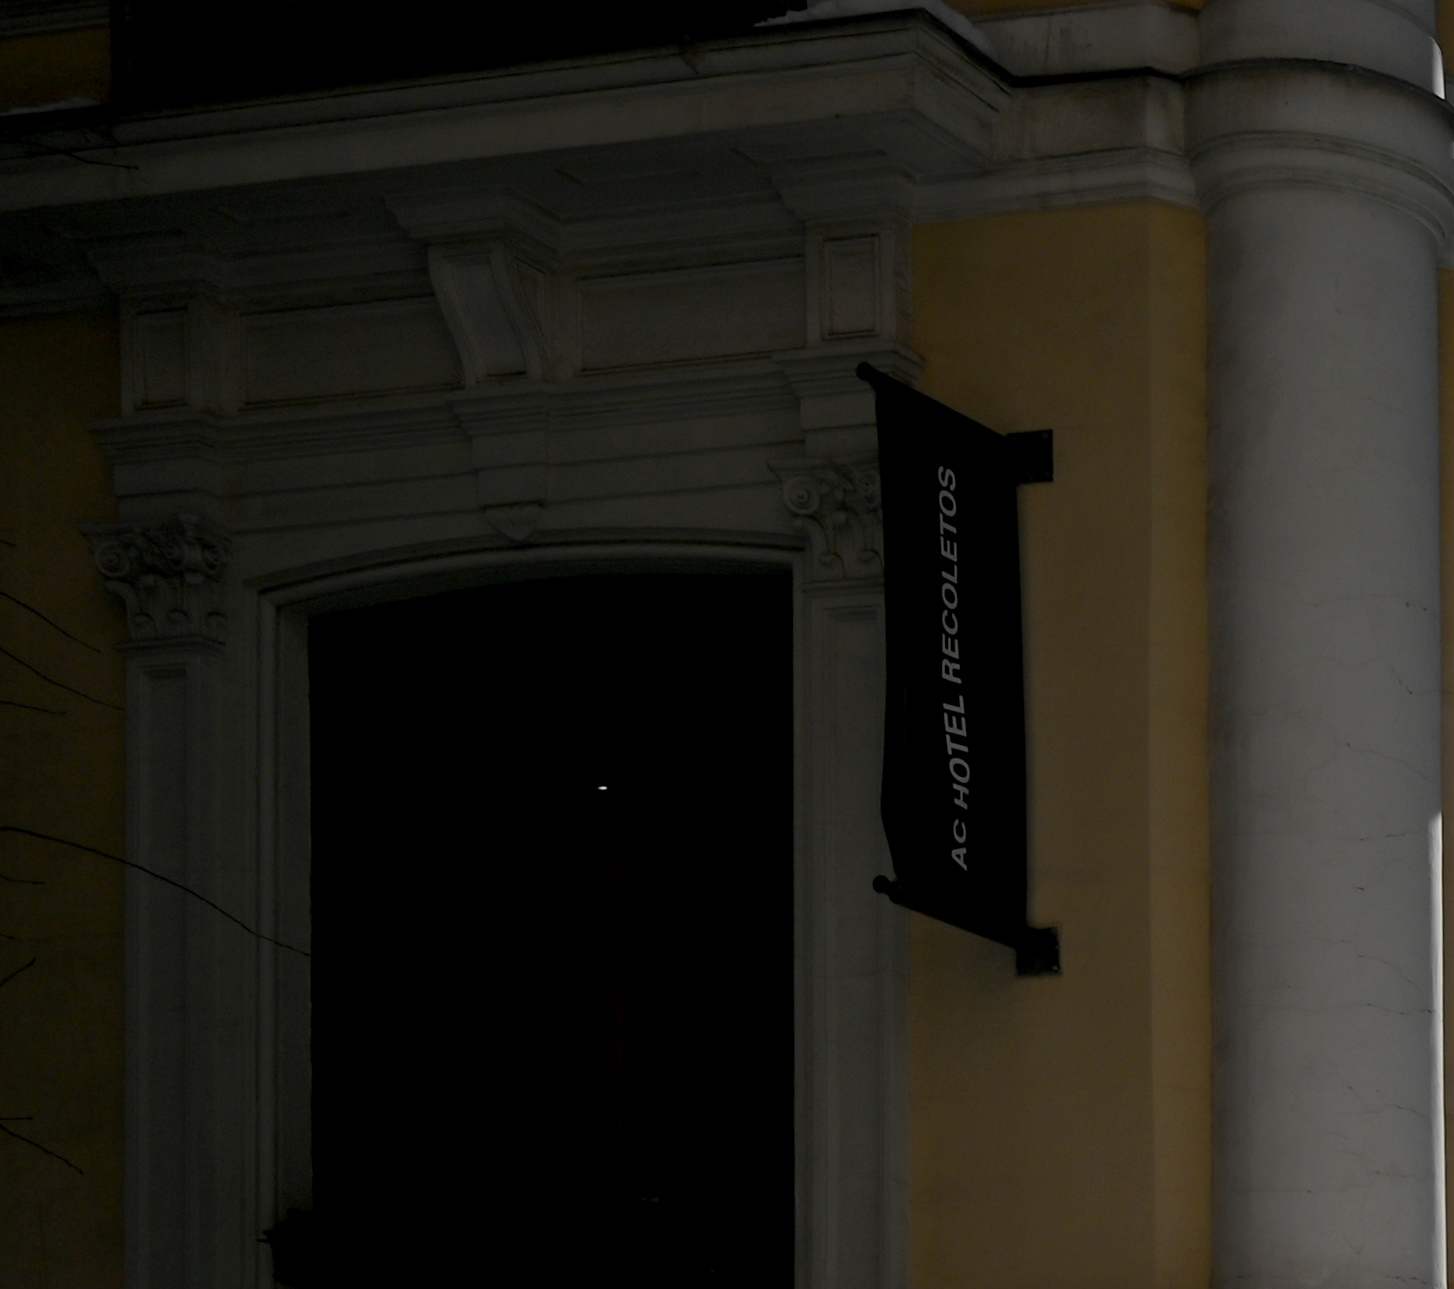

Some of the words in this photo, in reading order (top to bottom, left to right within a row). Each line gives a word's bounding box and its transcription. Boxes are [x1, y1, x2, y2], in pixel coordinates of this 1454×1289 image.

[936, 463, 964, 687] RECOLETOS
[943, 692, 970, 810] HOTEL
[950, 817, 970, 873] AC
